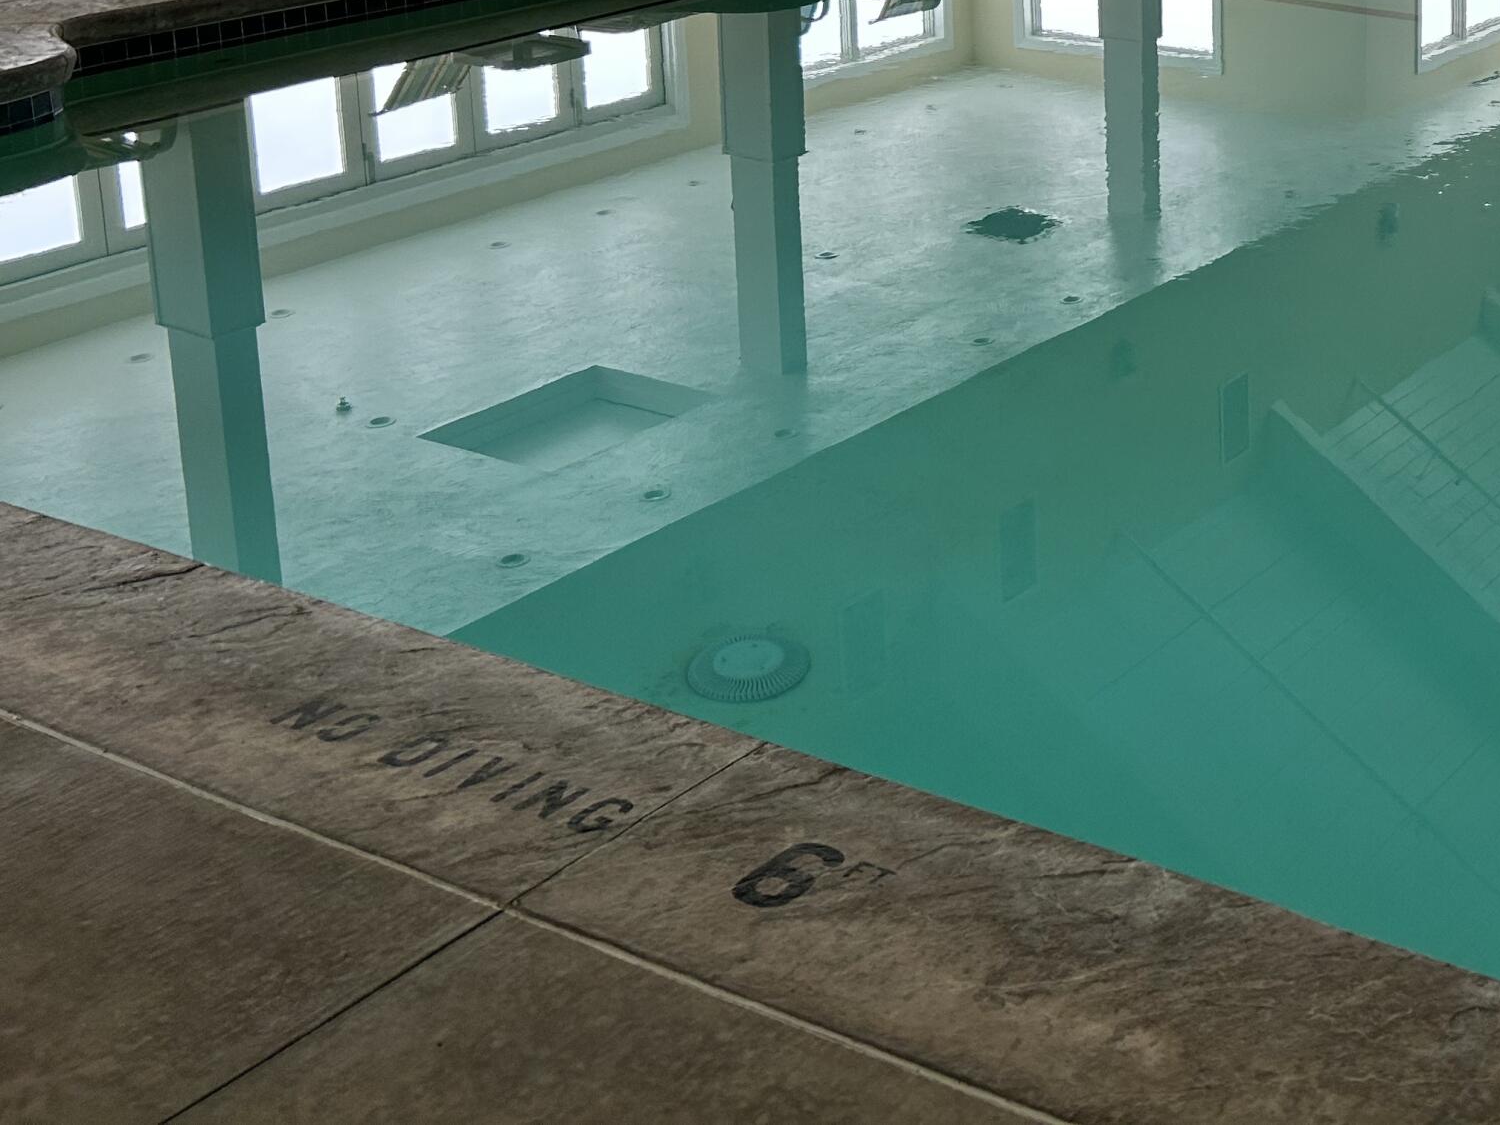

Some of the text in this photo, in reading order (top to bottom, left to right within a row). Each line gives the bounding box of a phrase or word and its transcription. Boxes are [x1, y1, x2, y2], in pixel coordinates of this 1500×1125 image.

[269, 697, 635, 834] NO DIVING
[732, 842, 897, 908] 6 FT
